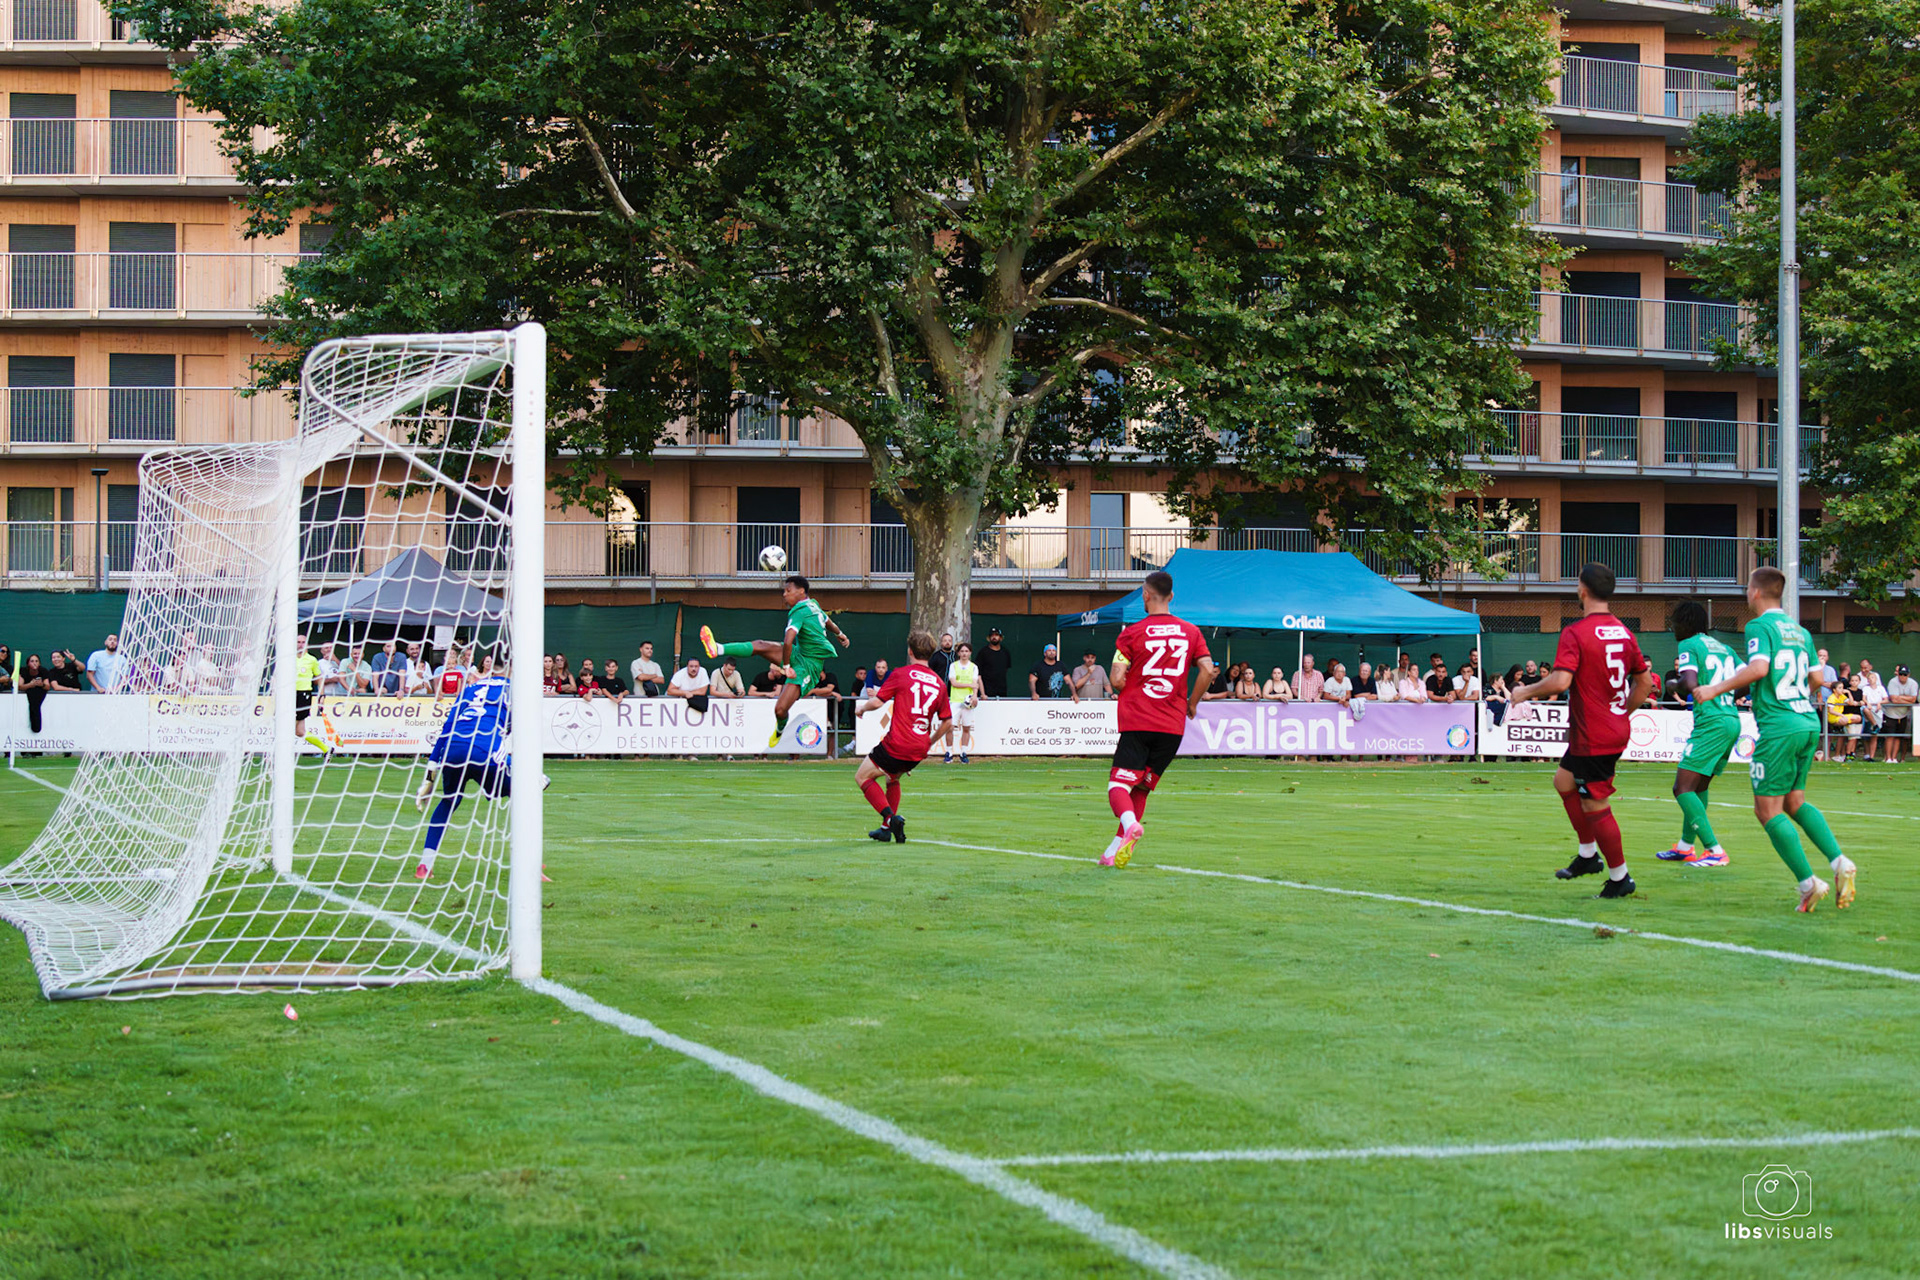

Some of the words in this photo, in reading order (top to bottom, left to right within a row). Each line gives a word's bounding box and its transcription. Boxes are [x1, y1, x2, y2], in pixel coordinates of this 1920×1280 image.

[1142, 638, 1189, 677] 23
[1605, 643, 1625, 688] 5
[1774, 648, 1811, 701] 20
[910, 682, 940, 716] 17
[617, 703, 730, 727] RENON
[1047, 710, 1106, 720] Showroom
[1008, 727, 1021, 735] Av.
[1023, 727, 1034, 735] de
[1036, 727, 1057, 735] Cour
[1059, 727, 1072, 735] 78
[1081, 727, 1102, 735] 1007
[1104, 727, 1119, 735] Lau
[1199, 706, 1355, 750] valiant
[1510, 727, 1566, 741] SPORT
[1631, 727, 1660, 735] ISSAN
[3, 735, 75, 749] Assurances
[617, 733, 745, 749] DÉSINFECTION
[1000, 738, 1008, 746] T.
[1010, 738, 1025, 746] 021
[1027, 738, 1046, 746] 624
[1049, 738, 1062, 746] 05
[1064, 738, 1076, 746] 37
[1364, 738, 1425, 751] MORGES
[1507, 744, 1522, 752] JF
[1525, 744, 1543, 753] SA
[1630, 750, 1650, 758] 021
[1653, 751, 1674, 759] 647
